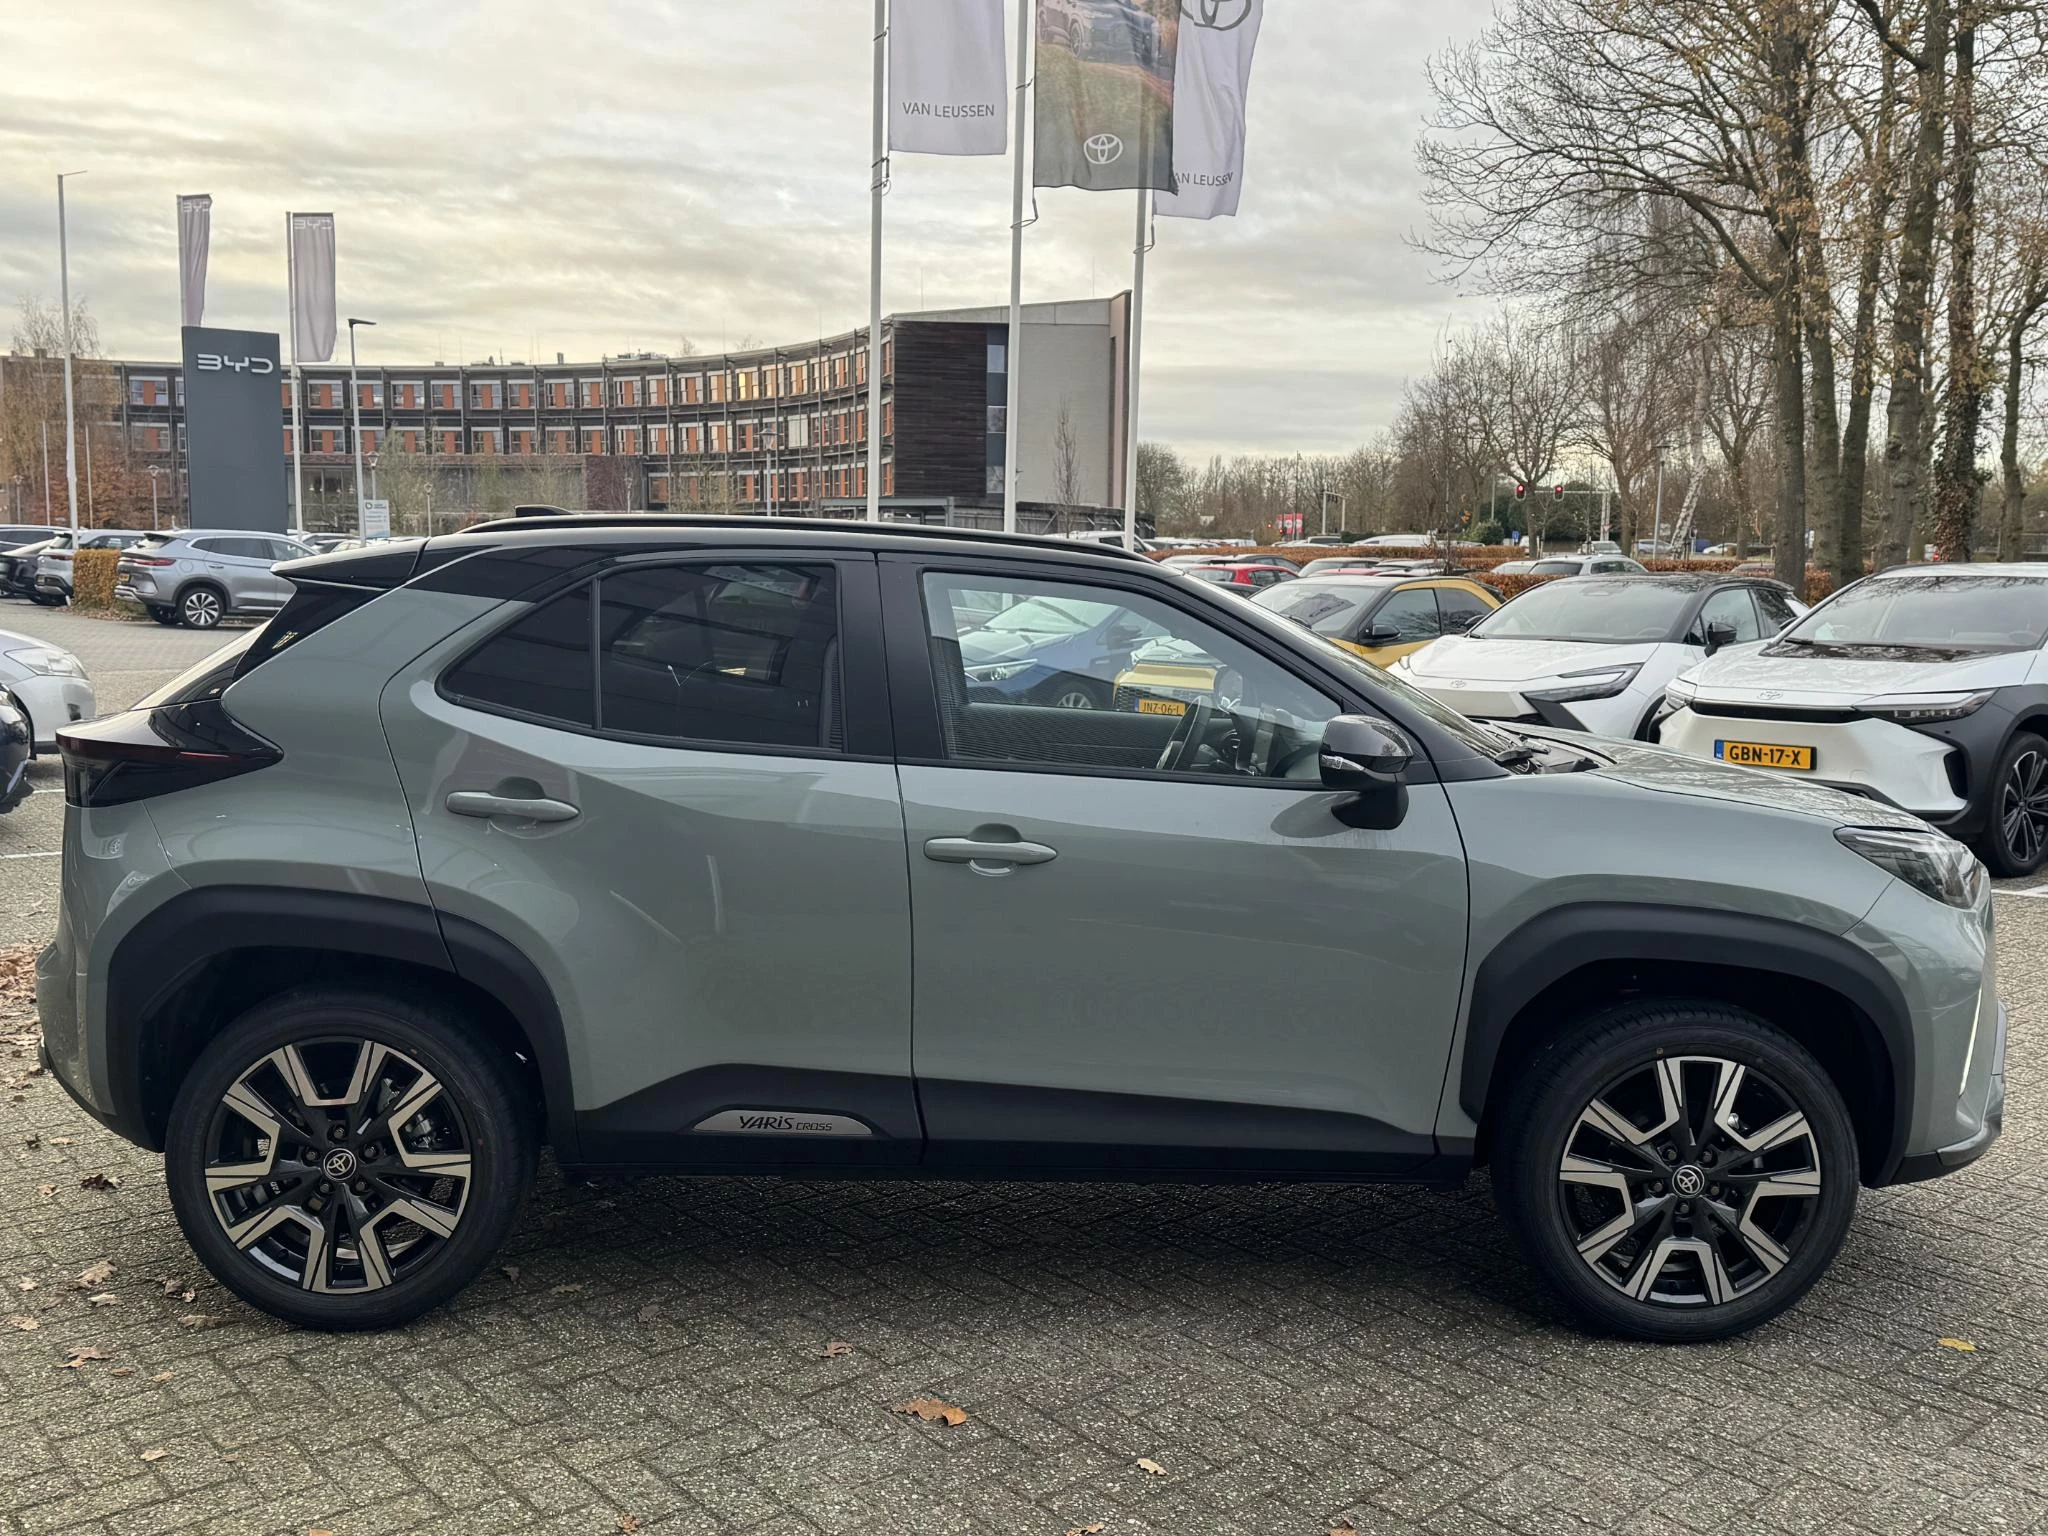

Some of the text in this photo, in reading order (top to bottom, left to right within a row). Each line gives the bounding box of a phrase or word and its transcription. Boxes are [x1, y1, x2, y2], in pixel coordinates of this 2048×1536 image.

[902, 102, 995, 118] VAN LEUSSEN
[1173, 172, 1190, 184] AN
[294, 219, 333, 230] BYD
[197, 353, 274, 374] BYD
[1729, 745, 1801, 766] GBN-17-X
[795, 1122, 833, 1132] CROSS
